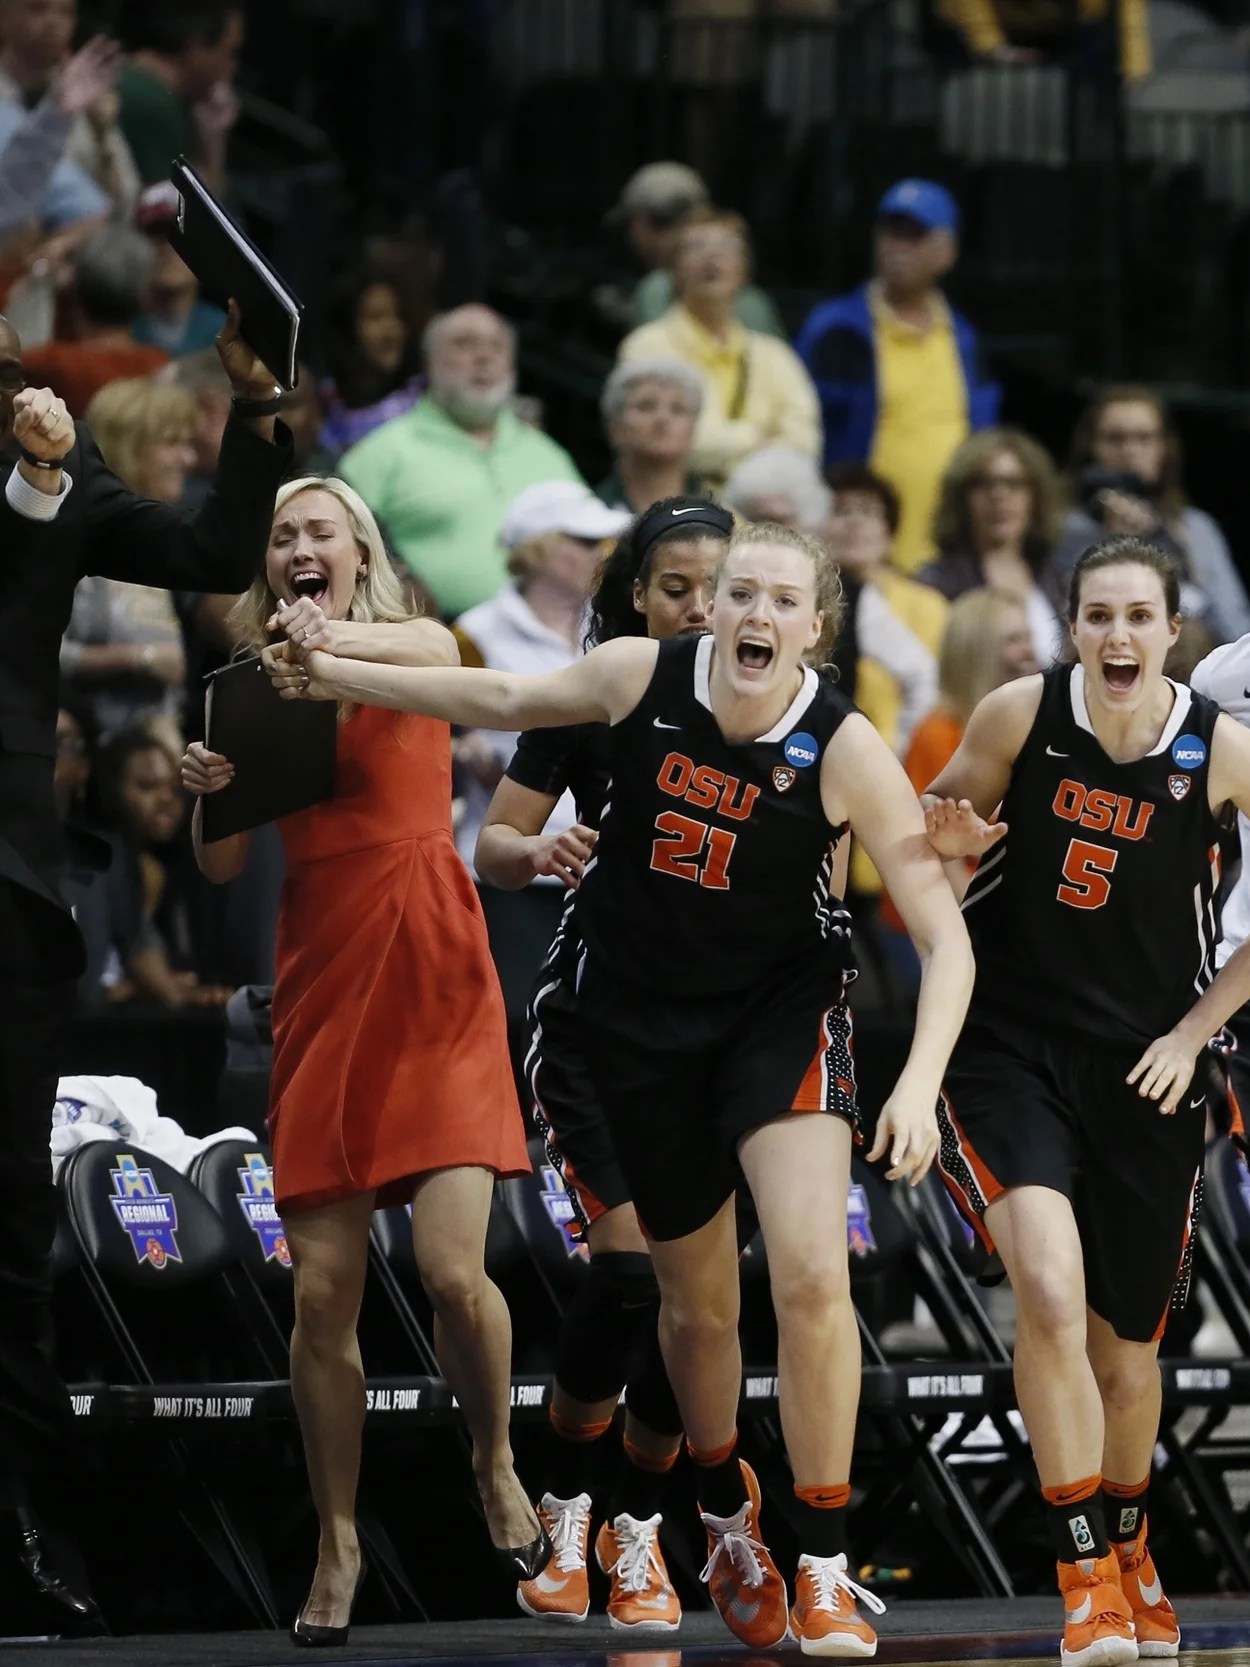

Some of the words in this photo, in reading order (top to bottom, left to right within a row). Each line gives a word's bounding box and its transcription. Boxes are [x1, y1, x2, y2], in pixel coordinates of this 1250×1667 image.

[787, 746, 815, 761] NCAA
[1176, 749, 1204, 761] NCAA
[656, 751, 761, 821] OSU
[1052, 778, 1155, 841] OSU
[650, 810, 737, 890] 21
[1056, 837, 1118, 910] 5
[120, 1203, 170, 1223] REGIONAL
[374, 1390, 391, 1410] ALL
[392, 1389, 419, 1410] FOUR
[516, 1385, 544, 1406] FOUR
[153, 1397, 182, 1417] WHAT
[183, 1398, 203, 1417] IT'S
[204, 1398, 222, 1417] ALL
[224, 1397, 251, 1417] FOUR
